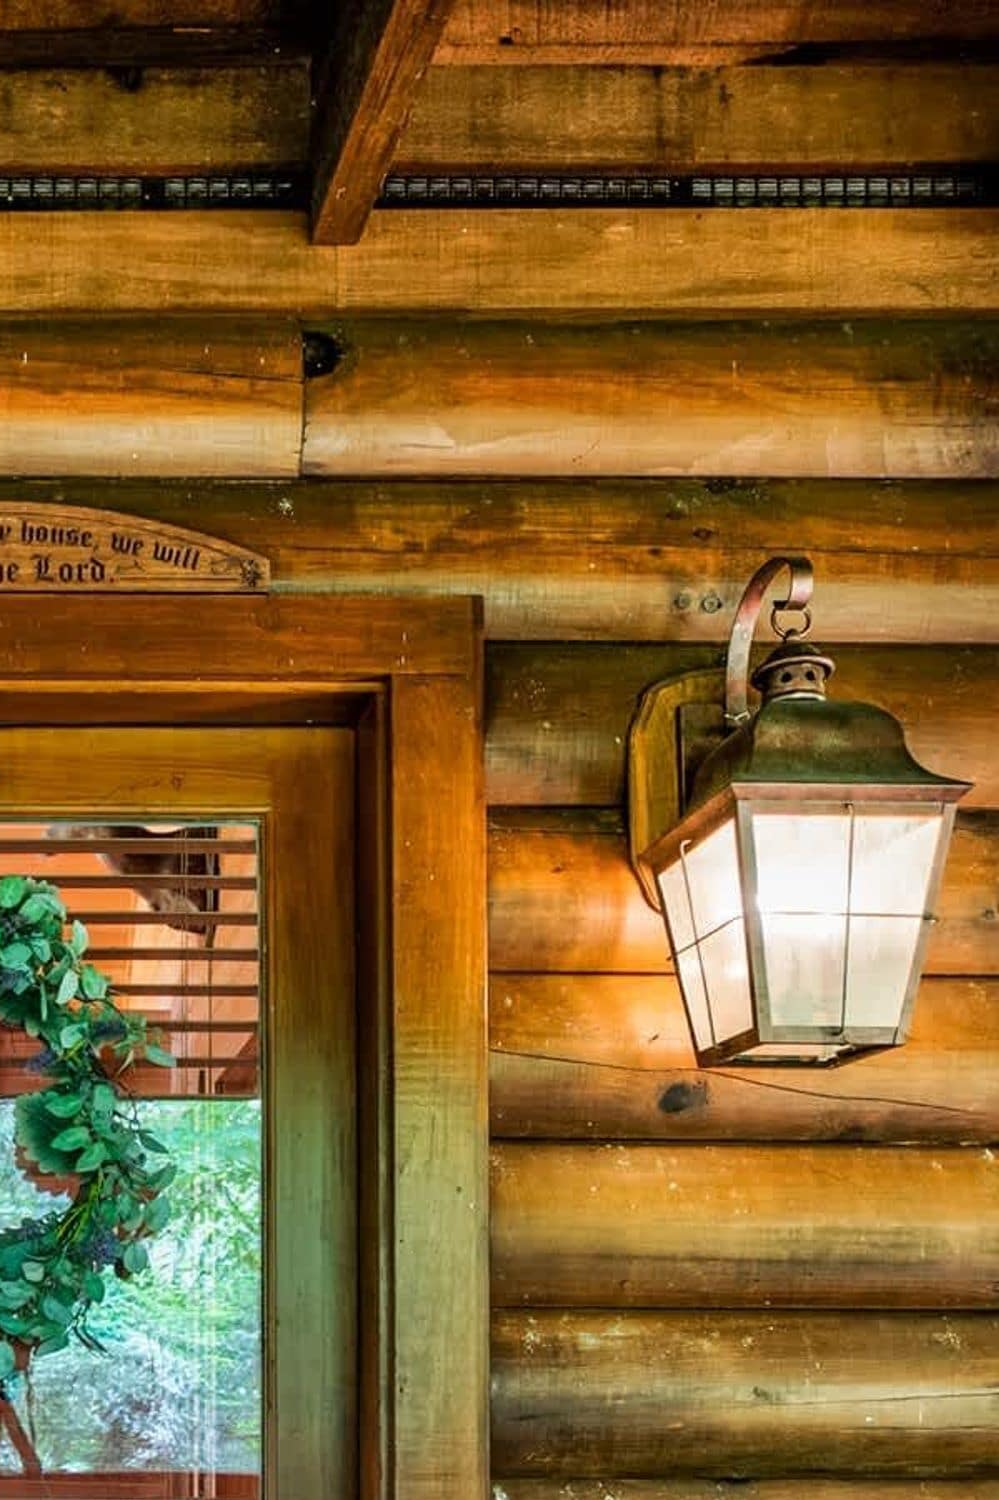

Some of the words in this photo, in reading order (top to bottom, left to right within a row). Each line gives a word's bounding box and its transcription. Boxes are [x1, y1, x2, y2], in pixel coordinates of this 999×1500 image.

[21, 520, 99, 552] house,
[111, 532, 144, 555] we
[153, 541, 200, 570] will
[31, 554, 115, 583] Lord.
